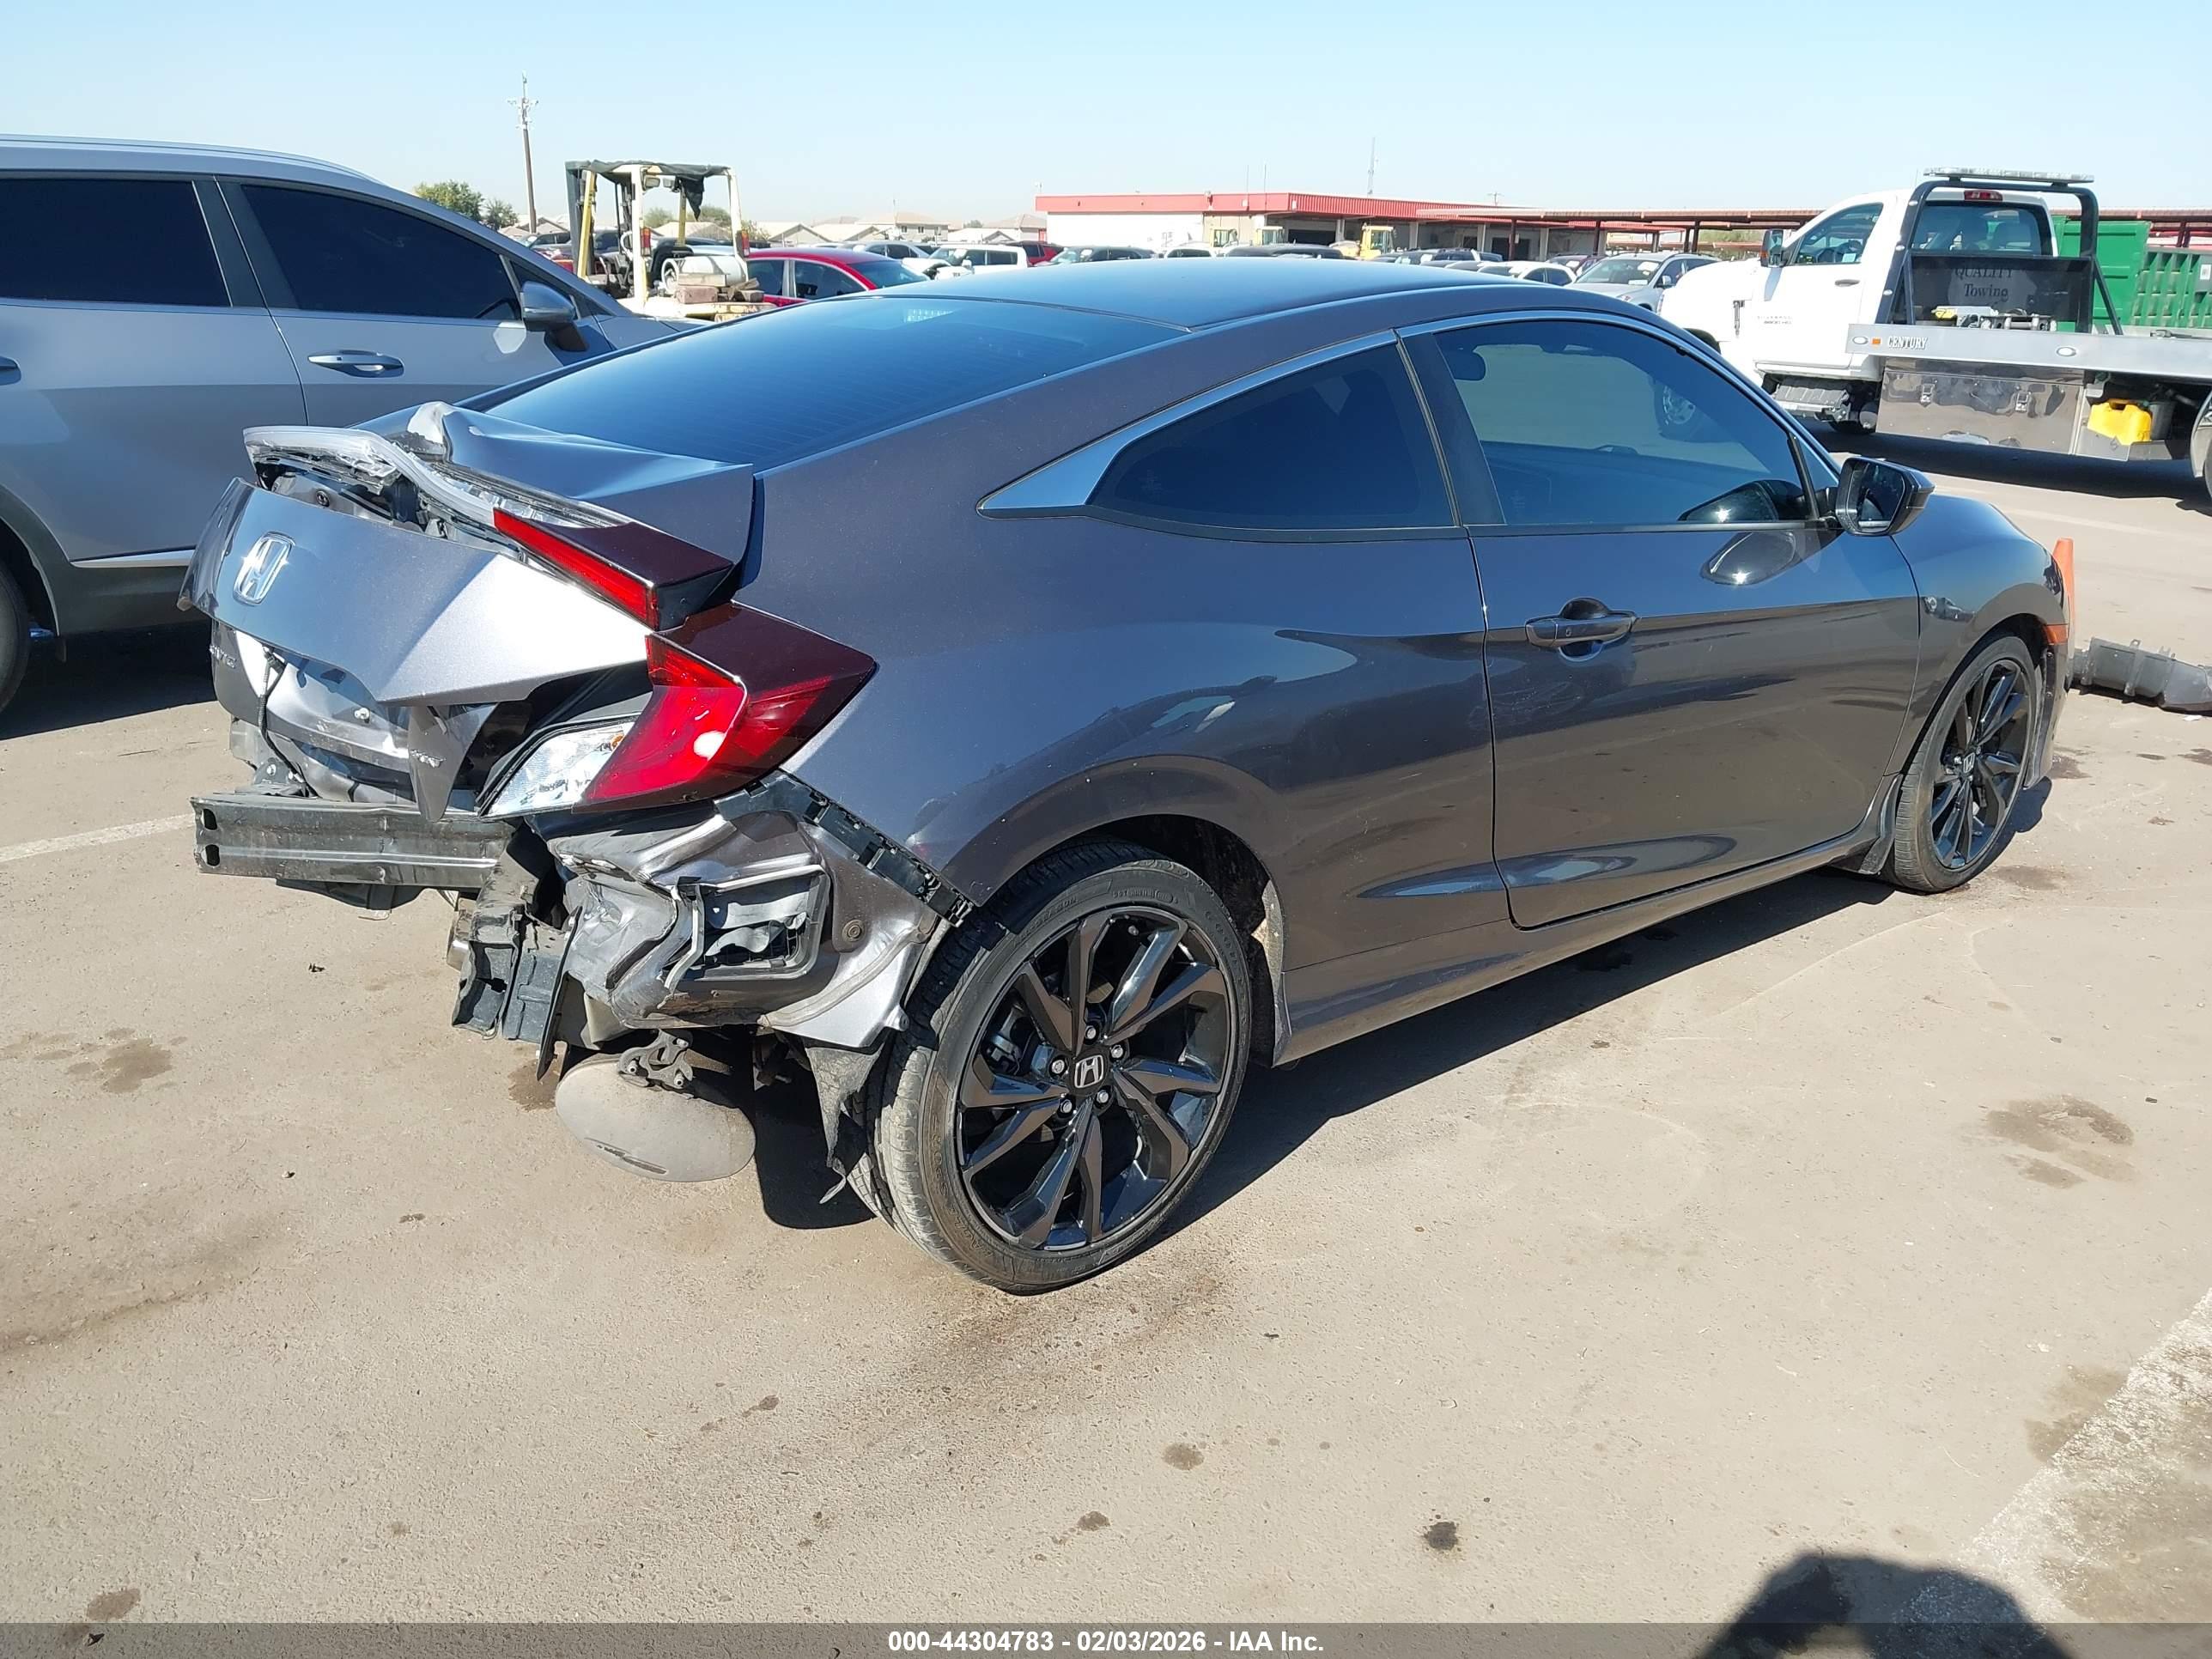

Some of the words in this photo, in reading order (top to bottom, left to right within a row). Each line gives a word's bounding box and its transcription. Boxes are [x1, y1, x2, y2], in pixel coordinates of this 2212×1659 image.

[1954, 268, 2012, 280] QUALITY
[1964, 283, 2008, 302] Towing
[1888, 336, 1928, 350] CENTURY
